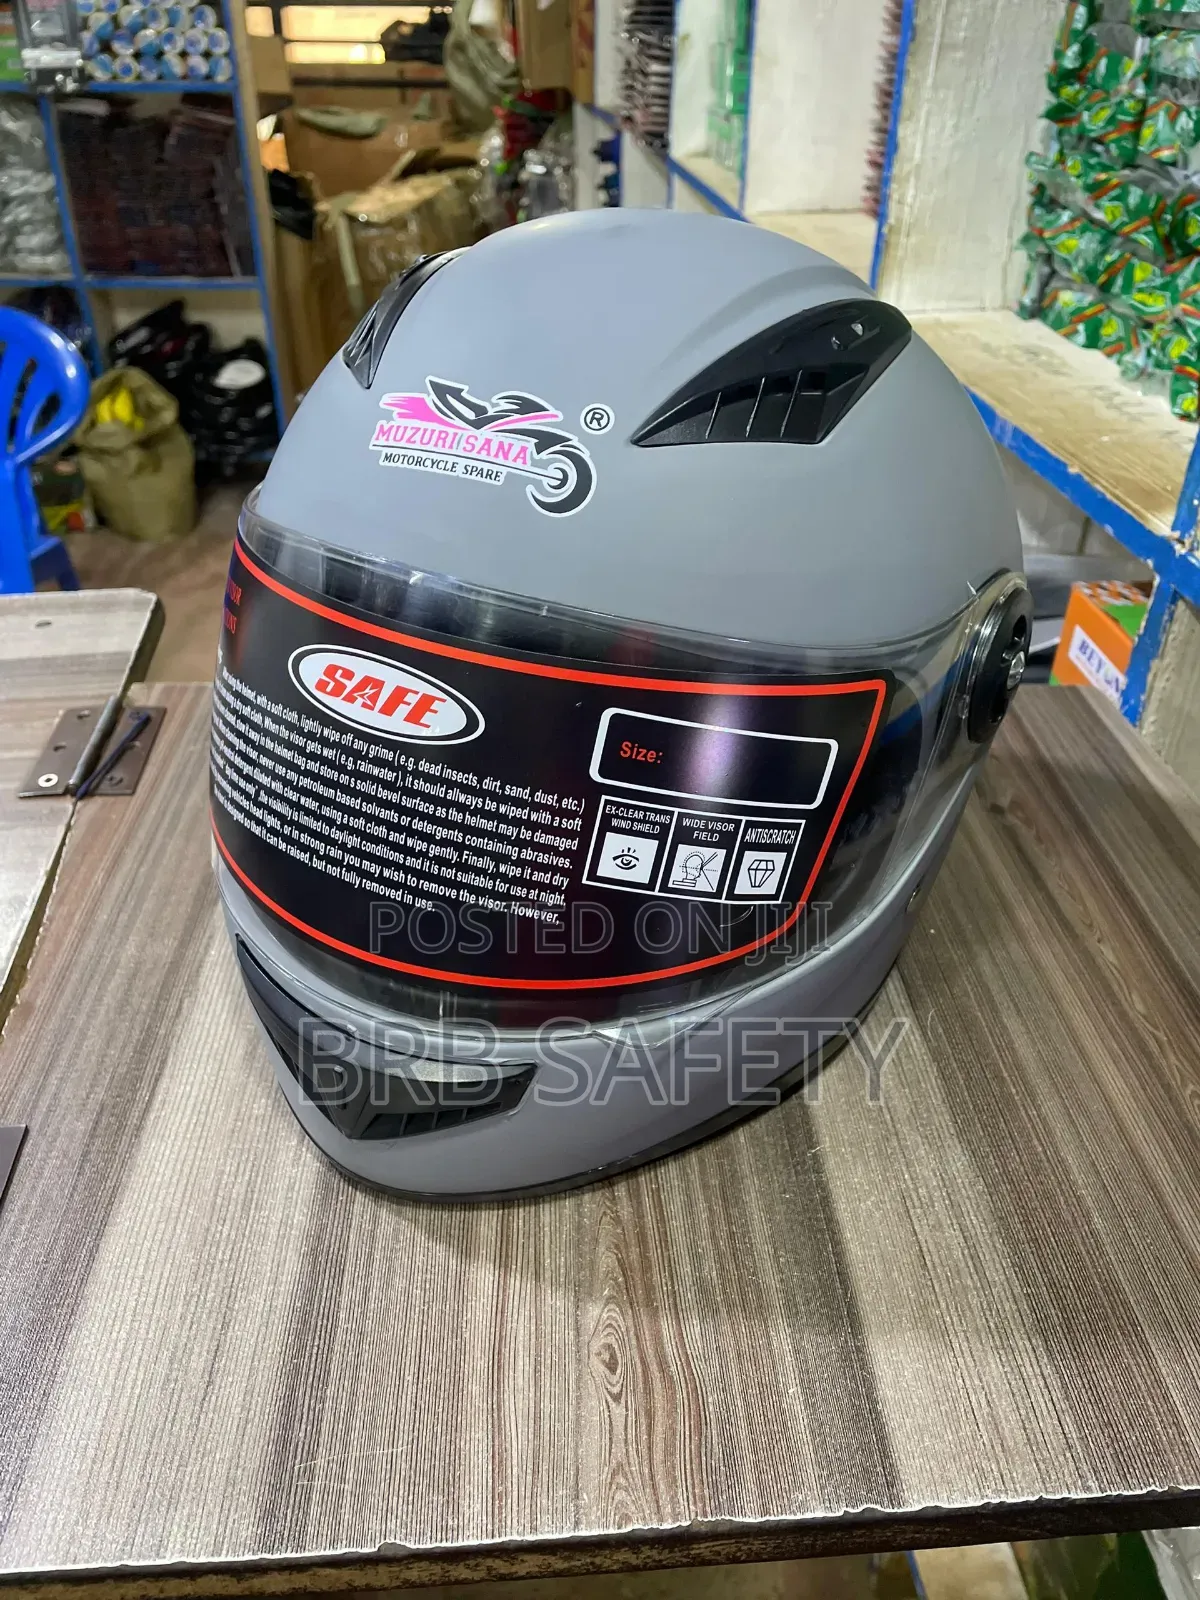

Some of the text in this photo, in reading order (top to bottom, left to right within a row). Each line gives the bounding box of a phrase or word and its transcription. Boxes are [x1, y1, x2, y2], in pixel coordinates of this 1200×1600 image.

[374, 423, 531, 466] MUZURI SANA
[382, 452, 503, 482] MOTORCYCLE SPARE
[314, 663, 447, 728] SAFE
[242, 682, 256, 704] helmet,
[257, 694, 267, 709] with
[267, 701, 272, 711] a
[271, 703, 283, 717] soft
[283, 707, 299, 727] cloth,
[301, 714, 323, 738] lightly
[323, 726, 340, 742] wipe
[341, 733, 354, 747] off
[353, 739, 368, 755] any
[369, 744, 393, 761] grime
[400, 753, 416, 770] e.g.
[418, 758, 442, 777] dead
[442, 764, 480, 790] insects,
[482, 777, 502, 796] dirt,
[504, 784, 532, 803] sand,
[534, 789, 559, 810] dust,
[561, 797, 585, 815] etc.)
[242, 705, 251, 718] soft
[251, 709, 263, 728] cloth,
[264, 716, 280, 735] When
[280, 725, 289, 739] the
[290, 731, 306, 747] visor
[306, 740, 321, 755] gets
[323, 746, 336, 761] wet
[357, 760, 397, 782] rainwater
[405, 773, 412, 788] it
[413, 777, 445, 797] should
[447, 787, 483, 809] allways
[485, 796, 497, 812] be
[499, 801, 530, 822] wiped
[531, 808, 551, 826] with
[553, 816, 559, 827] a
[561, 817, 582, 832] soft
[619, 740, 664, 764] Size:
[246, 744, 258, 763] visor,
[260, 754, 275, 770] never
[275, 763, 286, 776] use
[286, 769, 298, 785] any
[299, 774, 335, 800] petroleum
[336, 789, 361, 809] based
[362, 802, 399, 823] solvants
[400, 815, 411, 826] or
[412, 817, 463, 842] detergents
[465, 832, 518, 860] containing
[520, 847, 573, 869] abrasives.
[249, 728, 260, 745] away
[260, 733, 266, 746] in
[265, 737, 274, 751] the
[274, 741, 294, 761] helmet
[294, 751, 306, 770] bag
[306, 760, 320, 773] and
[320, 765, 339, 781] store
[340, 773, 349, 785] on
[350, 777, 355, 788] s
[356, 779, 377, 795] solid
[377, 784, 401, 804] bevel
[401, 796, 435, 815] surface
[435, 806, 446, 818] as
[448, 808, 463, 823] the
[465, 811, 498, 832] helmet
[498, 823, 518, 840] may
[520, 826, 532, 840] be
[533, 829, 578, 850] damaged
[605, 804, 671, 824] EX-CLEAR TRANS
[254, 767, 271, 787] diluted
[272, 780, 283, 794] with
[284, 786, 300, 802] clear
[300, 797, 320, 814] water,
[321, 806, 342, 824] using
[343, 813, 348, 824] a
[349, 816, 365, 831] soft
[366, 821, 387, 839] cloth
[388, 831, 406, 844] and
[406, 836, 427, 852] wipe
[429, 844, 460, 862] gently.
[462, 851, 497, 873] Finally,
[499, 862, 522, 880] wipe
[523, 867, 531, 879] it
[532, 868, 550, 884] and
[552, 873, 570, 890] dry
[268, 796, 292, 820] visibility
[292, 807, 298, 821] is
[299, 811, 322, 832] limited
[322, 822, 329, 835] to
[330, 826, 361, 848] daylight
[361, 840, 404, 864] conditions
[405, 856, 422, 869] and
[423, 859, 430, 872] it
[430, 861, 439, 875] is
[440, 865, 456, 879] not
[457, 869, 493, 891] suitable
[495, 879, 509, 893] for
[510, 884, 527, 899] use
[529, 888, 539, 900] at
[539, 889, 566, 907] night.
[611, 818, 660, 834] WIND SHIELD
[682, 818, 735, 832] WIDE VISOR
[693, 830, 719, 842] FIELD
[744, 827, 797, 845] ANTISCRATCH
[244, 817, 250, 829] so
[250, 820, 261, 837] that
[261, 827, 266, 840] it
[267, 833, 277, 847] can
[278, 837, 287, 851] be
[287, 844, 311, 867] raised,
[312, 855, 325, 871] but
[326, 864, 340, 878] not
[341, 868, 361, 888] fully
[362, 878, 403, 901] removed
[403, 891, 413, 904] in
[415, 897, 436, 912] use.
[250, 800, 263, 819] head
[263, 810, 282, 833] lights,
[283, 825, 291, 836] or
[292, 826, 299, 840] in
[300, 833, 325, 855] strong
[326, 845, 343, 860] rain
[344, 852, 360, 865] you
[362, 860, 381, 877] may
[383, 866, 405, 884] wish
[407, 873, 417, 887] to
[419, 879, 457, 899] remove
[459, 889, 476, 904] the
[478, 895, 508, 912] visor.
[510, 903, 560, 925] However,
